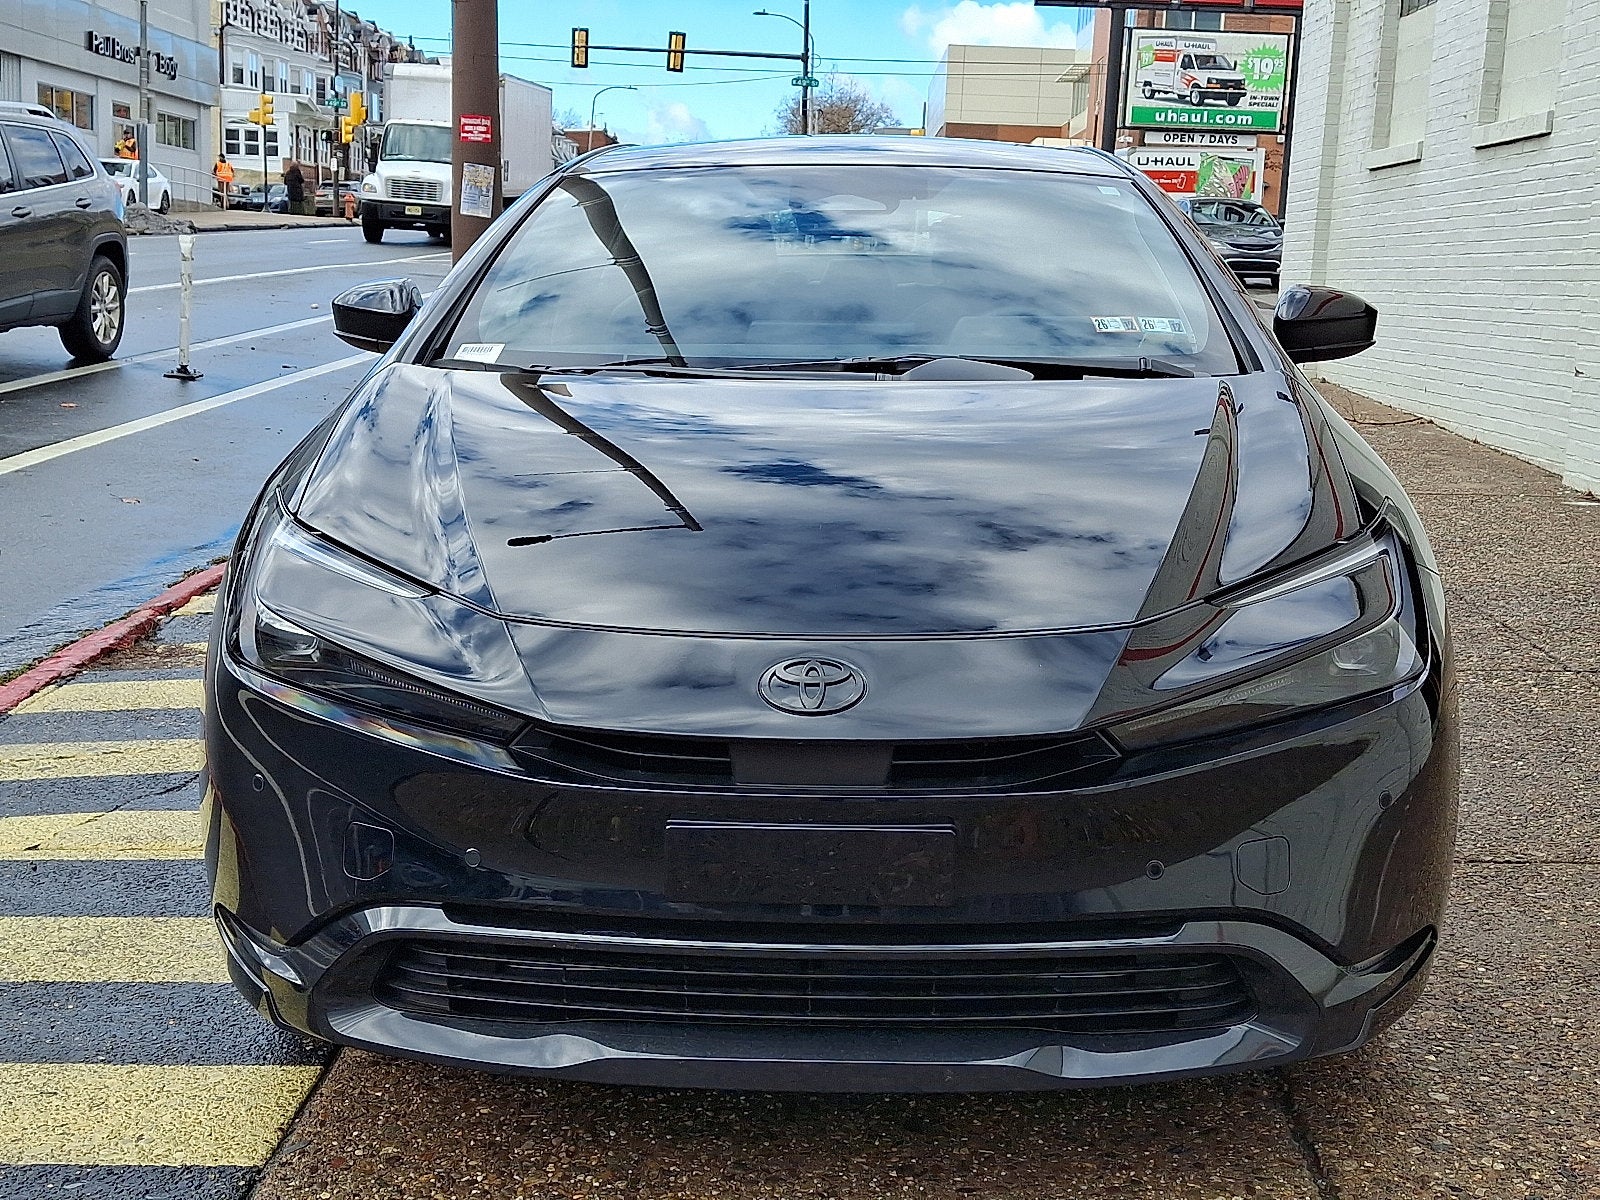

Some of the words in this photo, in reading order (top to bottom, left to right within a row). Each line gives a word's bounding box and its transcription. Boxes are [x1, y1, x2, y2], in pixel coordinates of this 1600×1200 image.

[1184, 42, 1211, 50] U-HAUL
[90, 30, 113, 57] Paul
[115, 38, 136, 65] Bros
[160, 53, 179, 80] Body
[1155, 110, 1253, 125] uhaul.com
[1163, 133, 1195, 143] OPEN
[1199, 134, 1205, 143] 7
[1209, 135, 1238, 145] DAYS
[1137, 156, 1195, 167] U-HAUL
[1094, 319, 1109, 330] 26
[1141, 319, 1155, 330] 26
